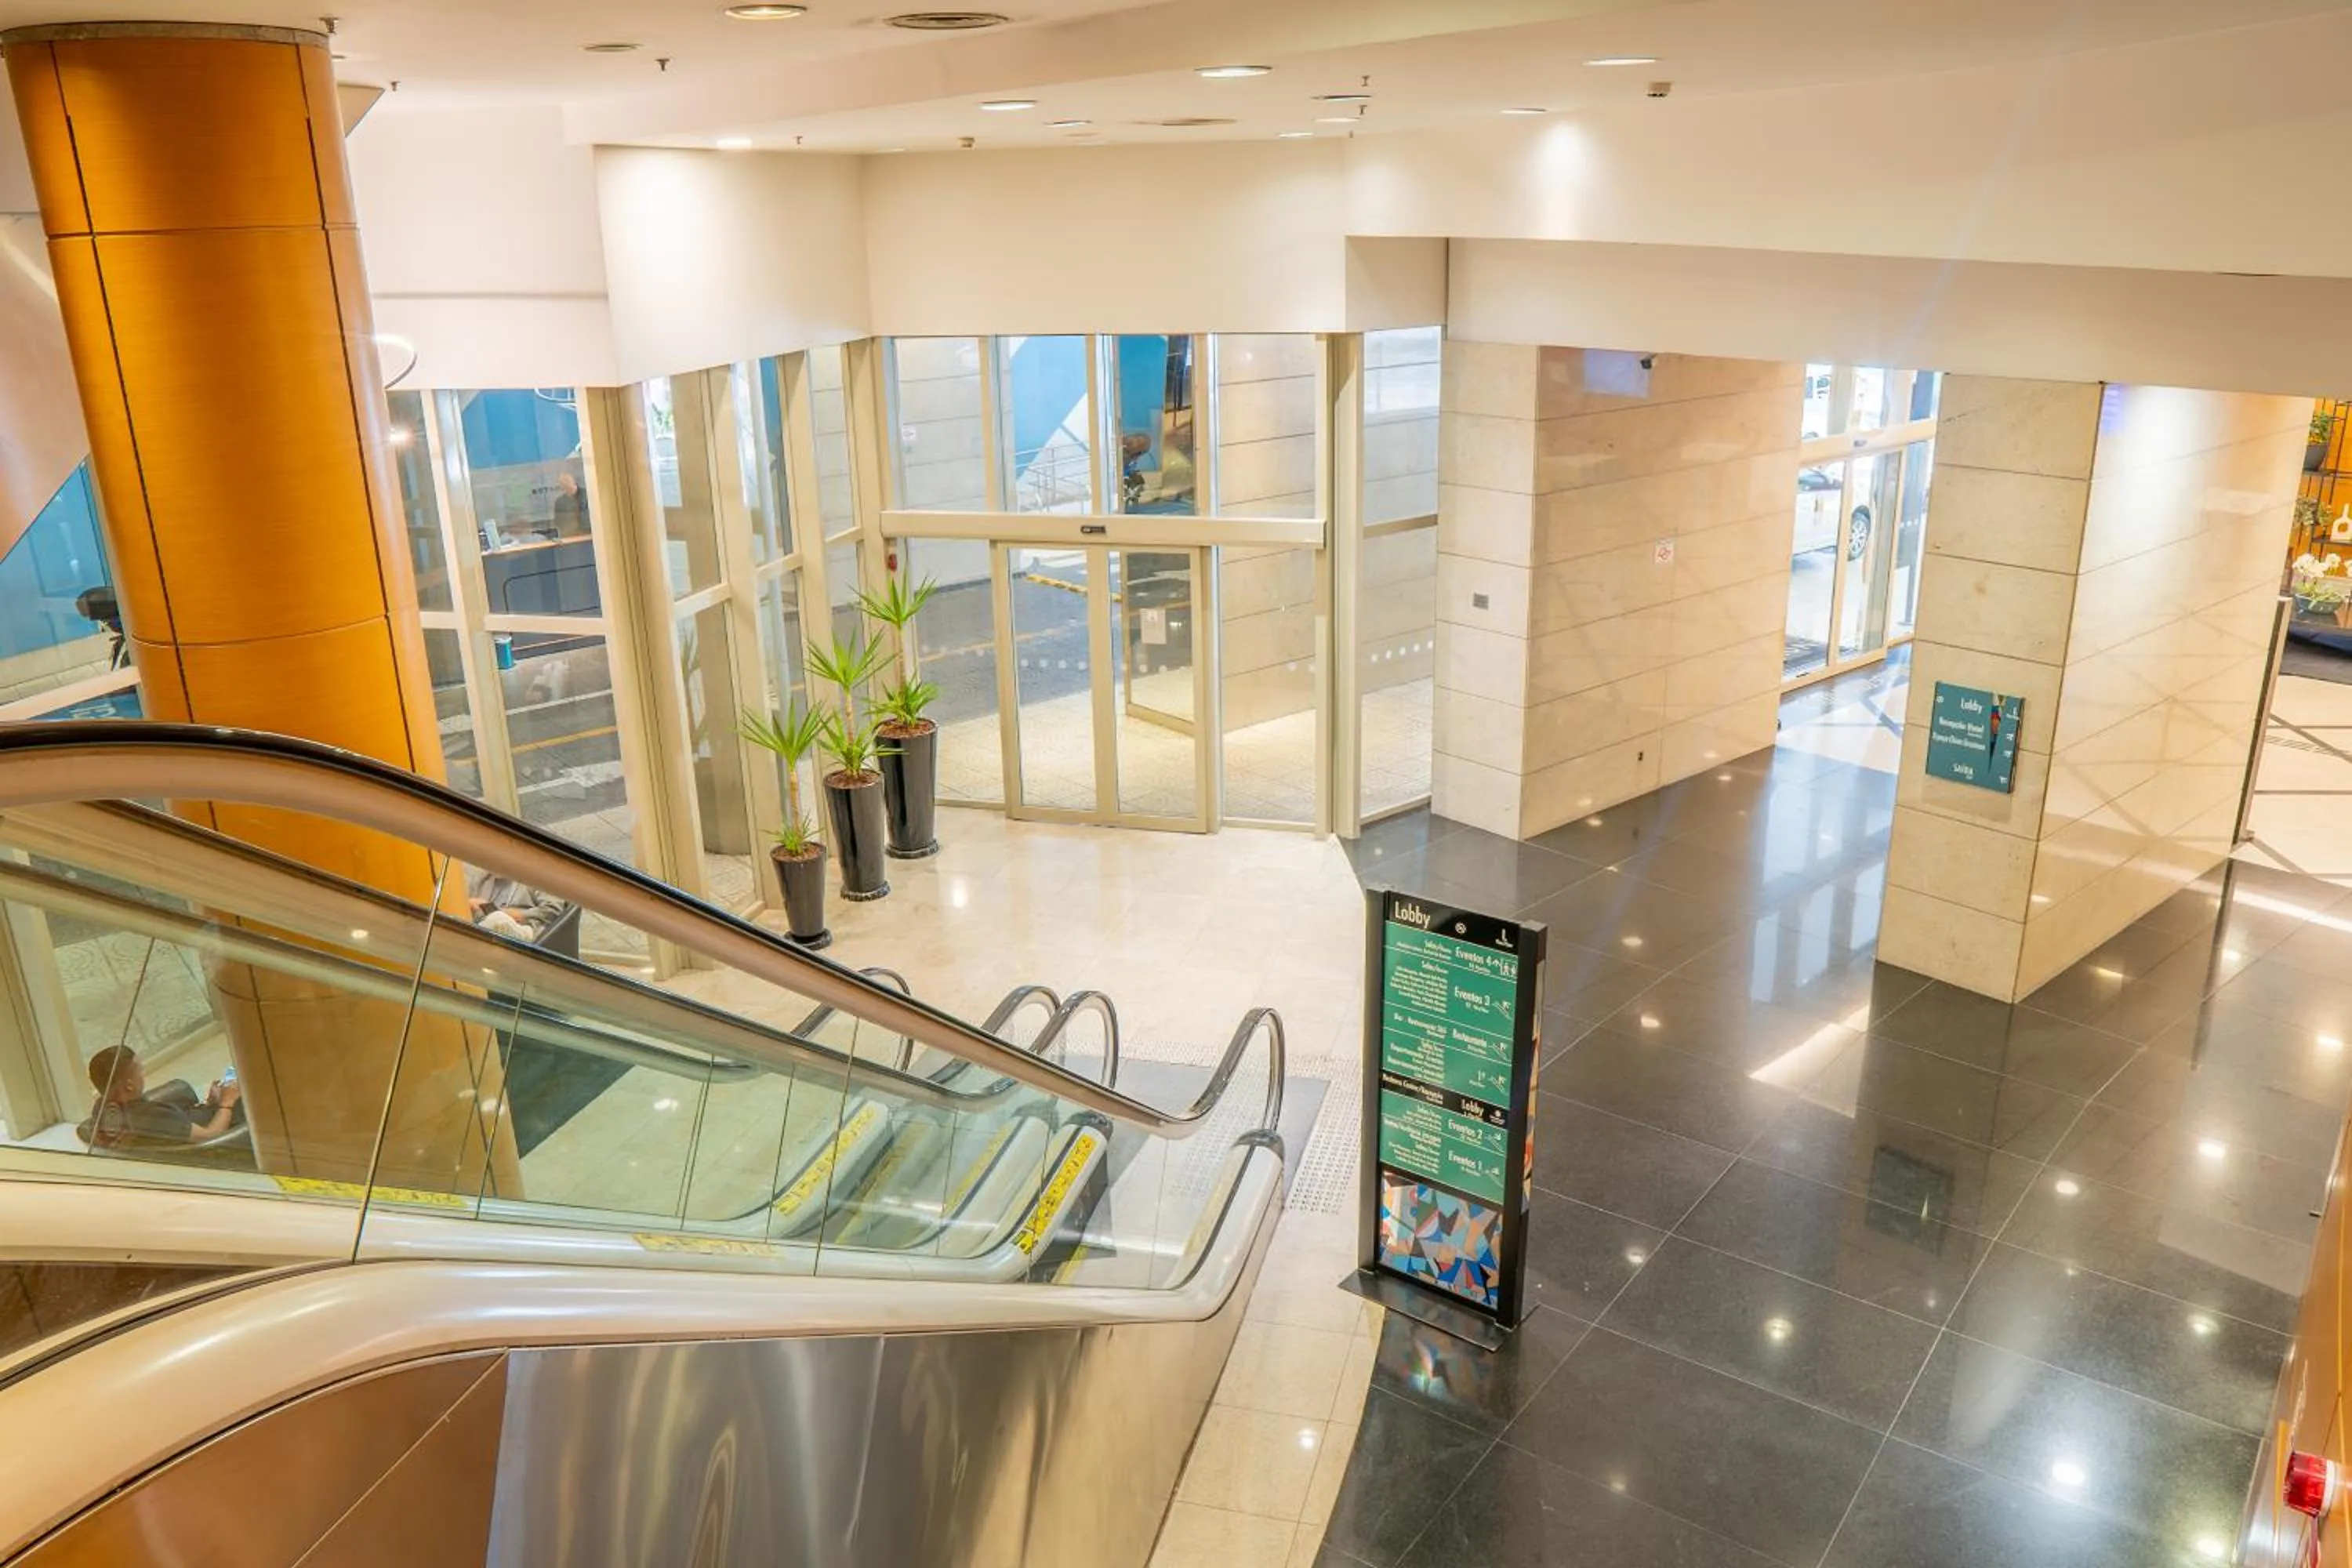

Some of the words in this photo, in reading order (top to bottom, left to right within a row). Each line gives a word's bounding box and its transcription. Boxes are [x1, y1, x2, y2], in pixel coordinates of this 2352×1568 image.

[1961, 697, 1983, 714] Lobby
[1395, 901, 1430, 928] Lobby
[1456, 947, 1484, 963] Eventos
[1454, 986, 1483, 1004] Eventos
[1484, 995, 1490, 1006] 3
[1461, 1099, 1484, 1116] Lobby
[1448, 1119, 1475, 1136] Eventos
[1476, 1127, 1483, 1139] 2
[1448, 1149, 1475, 1167] Eventos
